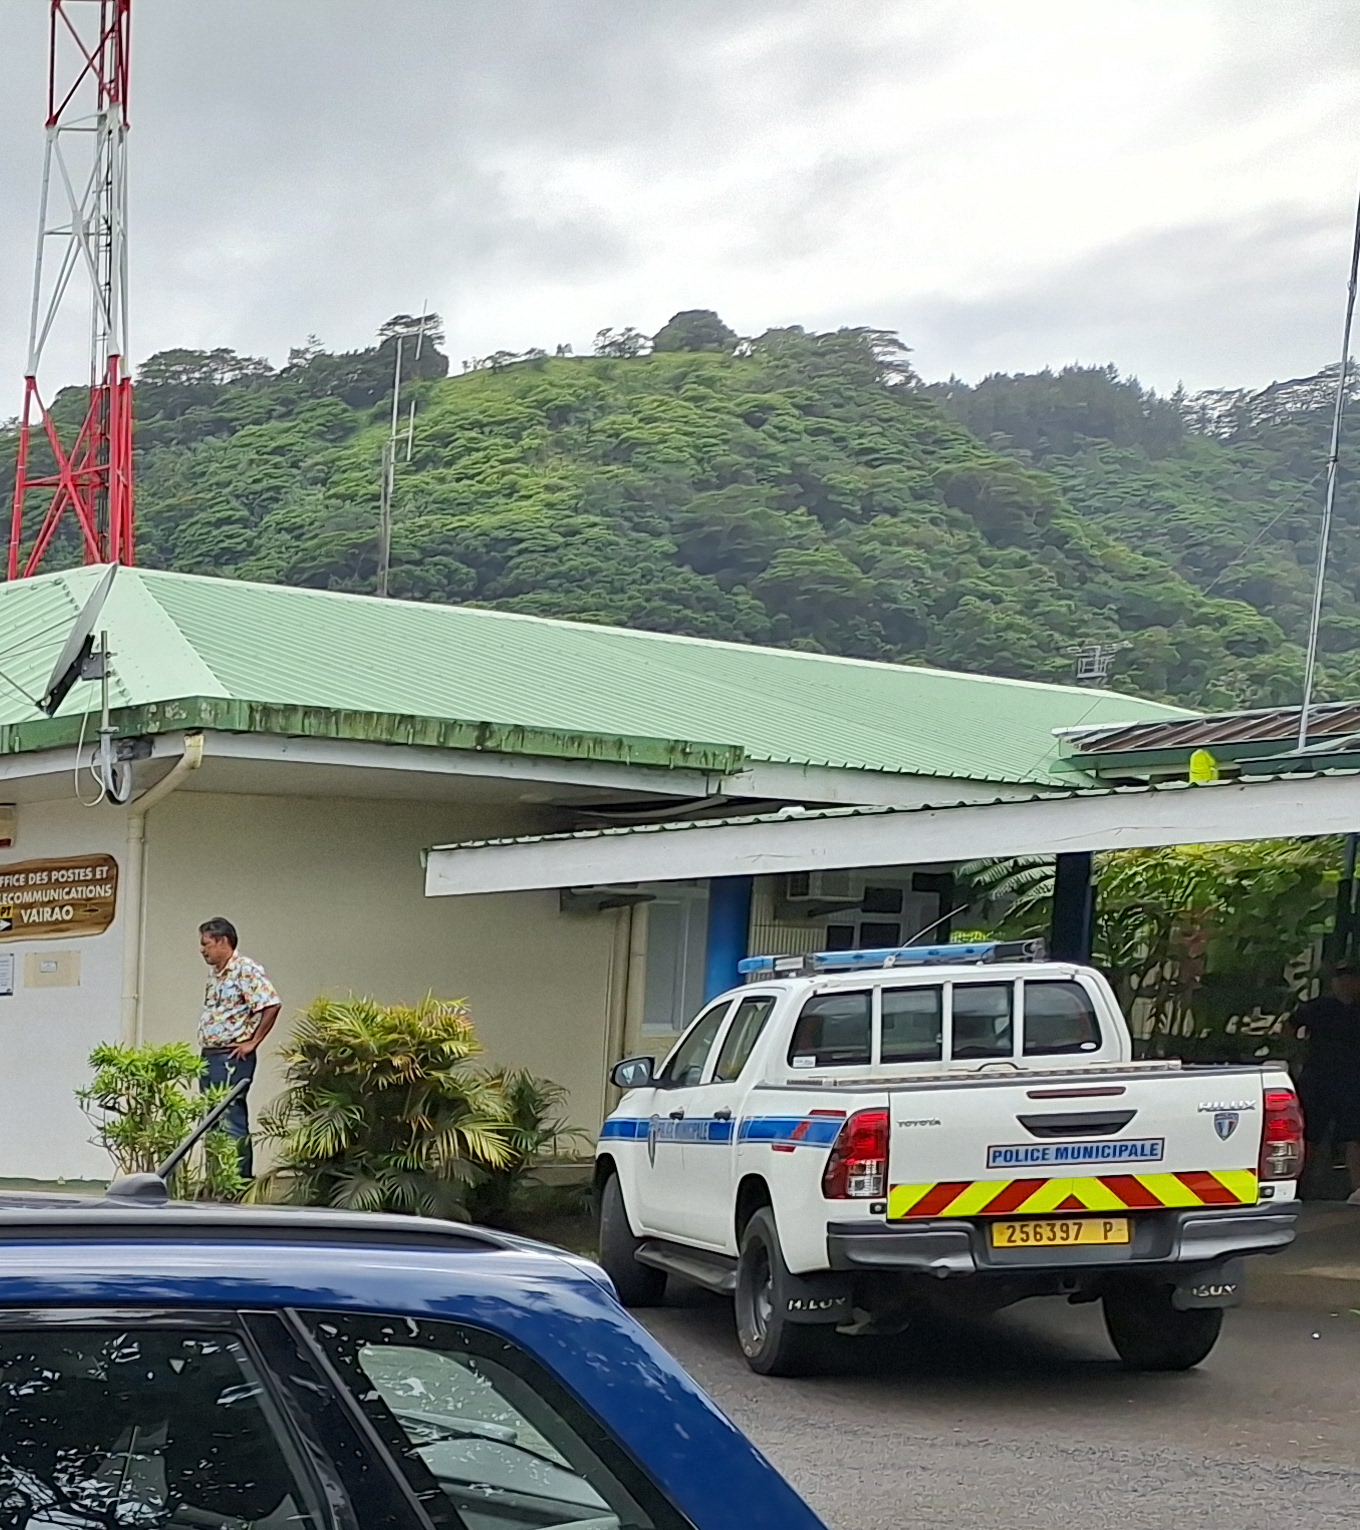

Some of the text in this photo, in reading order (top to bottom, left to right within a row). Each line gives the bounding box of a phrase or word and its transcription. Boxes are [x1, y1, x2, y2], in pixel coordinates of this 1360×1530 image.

[28, 871, 48, 885] DES
[51, 867, 93, 883] POSTES
[95, 866, 109, 880] ET
[20, 905, 74, 923] VAIRAO
[896, 1117, 942, 1128] TOYOTA
[991, 1142, 1160, 1164] POLICE MUNICIPALE
[1005, 1220, 1113, 1244] 256397 P
